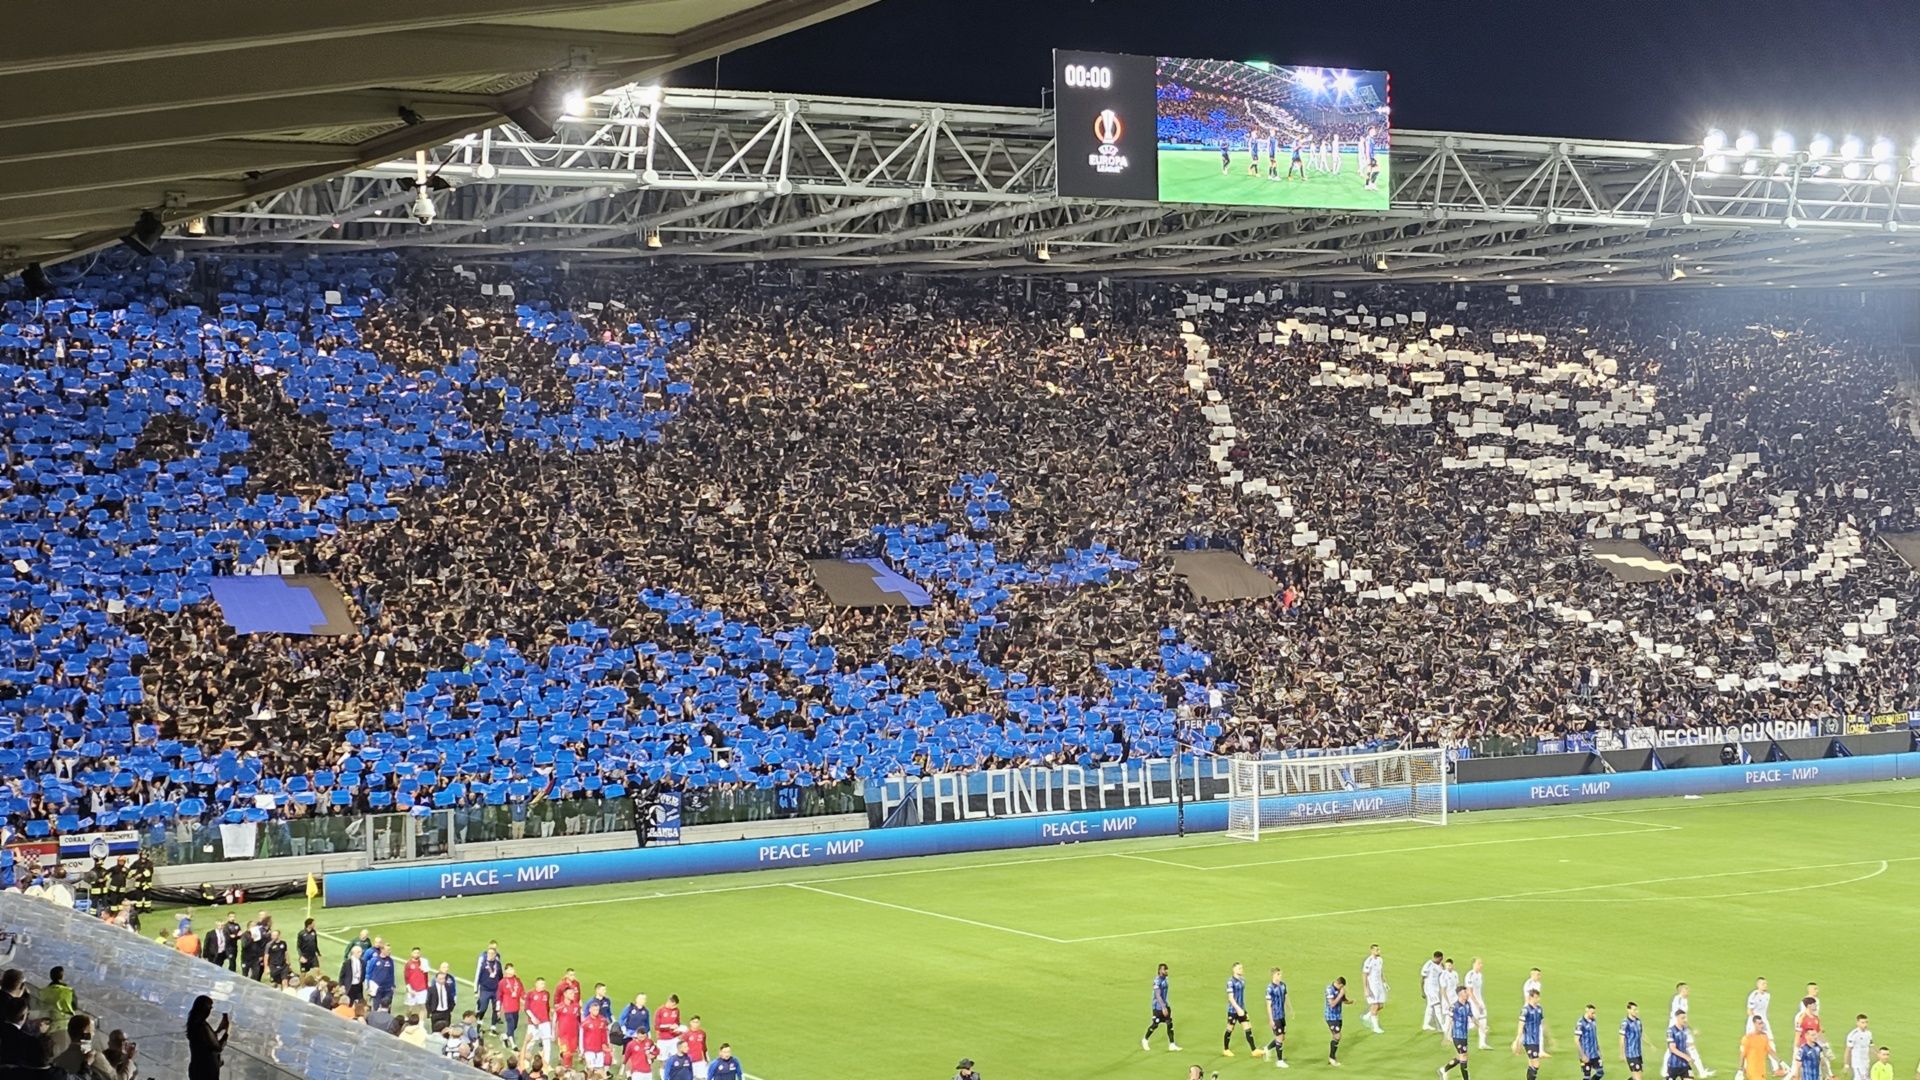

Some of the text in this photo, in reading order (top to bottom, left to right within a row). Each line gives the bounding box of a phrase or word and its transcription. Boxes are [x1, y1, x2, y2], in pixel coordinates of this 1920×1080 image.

[1065, 65, 1111, 88] 00:00
[1655, 727, 1722, 746] VECCHIA
[1741, 720, 1811, 742] GUARDIA
[1746, 769, 1782, 784] PEACE
[1792, 767, 1819, 780] МИР
[881, 765, 1087, 826] ATALANTA
[1531, 785, 1570, 799] PEACE
[1582, 782, 1611, 796] МИР
[1297, 801, 1339, 817] PEACE
[1042, 820, 1089, 838] PEACE
[1103, 816, 1137, 833] МИР
[760, 842, 811, 862] PEACE
[826, 839, 864, 856] МИР
[440, 869, 500, 889] PEACE
[517, 864, 560, 883] МИР
